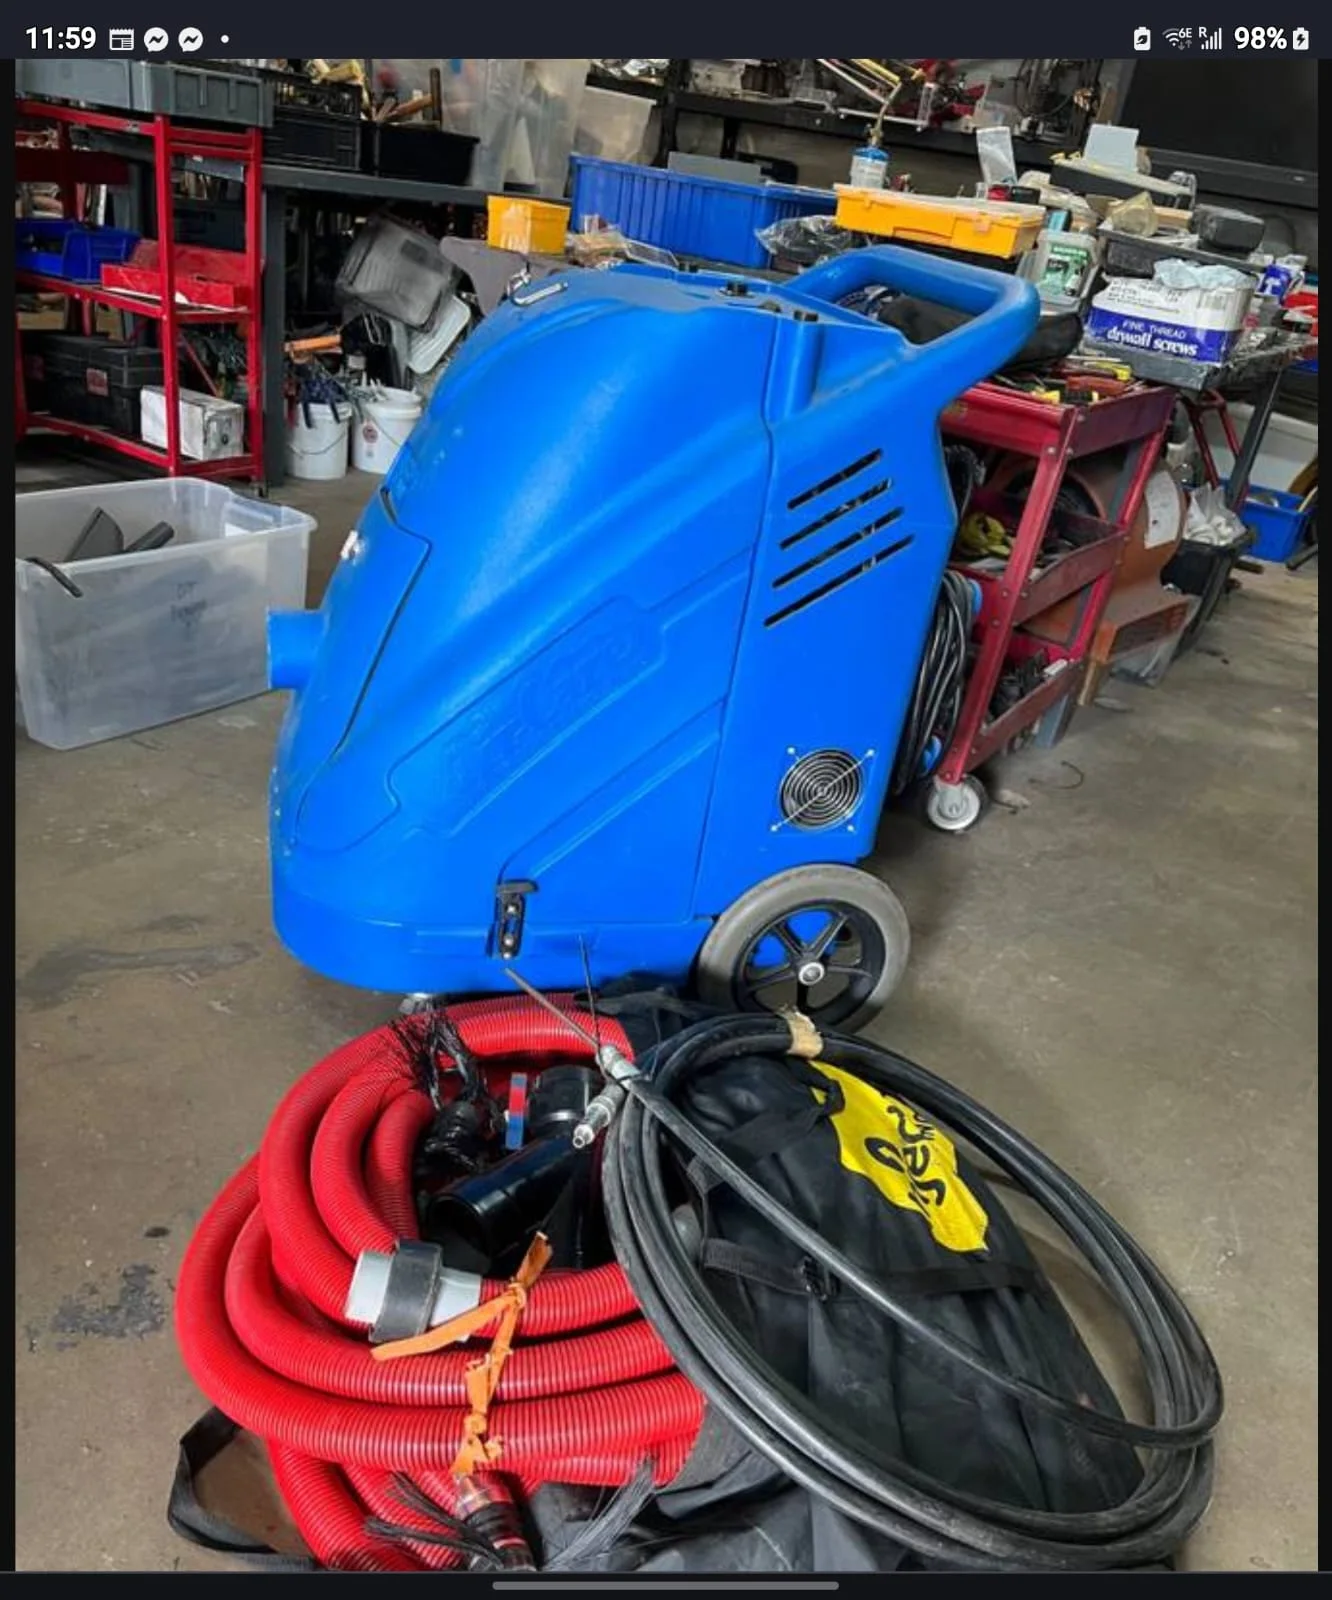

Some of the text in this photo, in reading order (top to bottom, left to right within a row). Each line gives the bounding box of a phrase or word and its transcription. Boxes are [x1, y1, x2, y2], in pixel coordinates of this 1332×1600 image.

[1106, 325, 1199, 357] drywall screws
[1121, 319, 1188, 340] FINE THREAD
